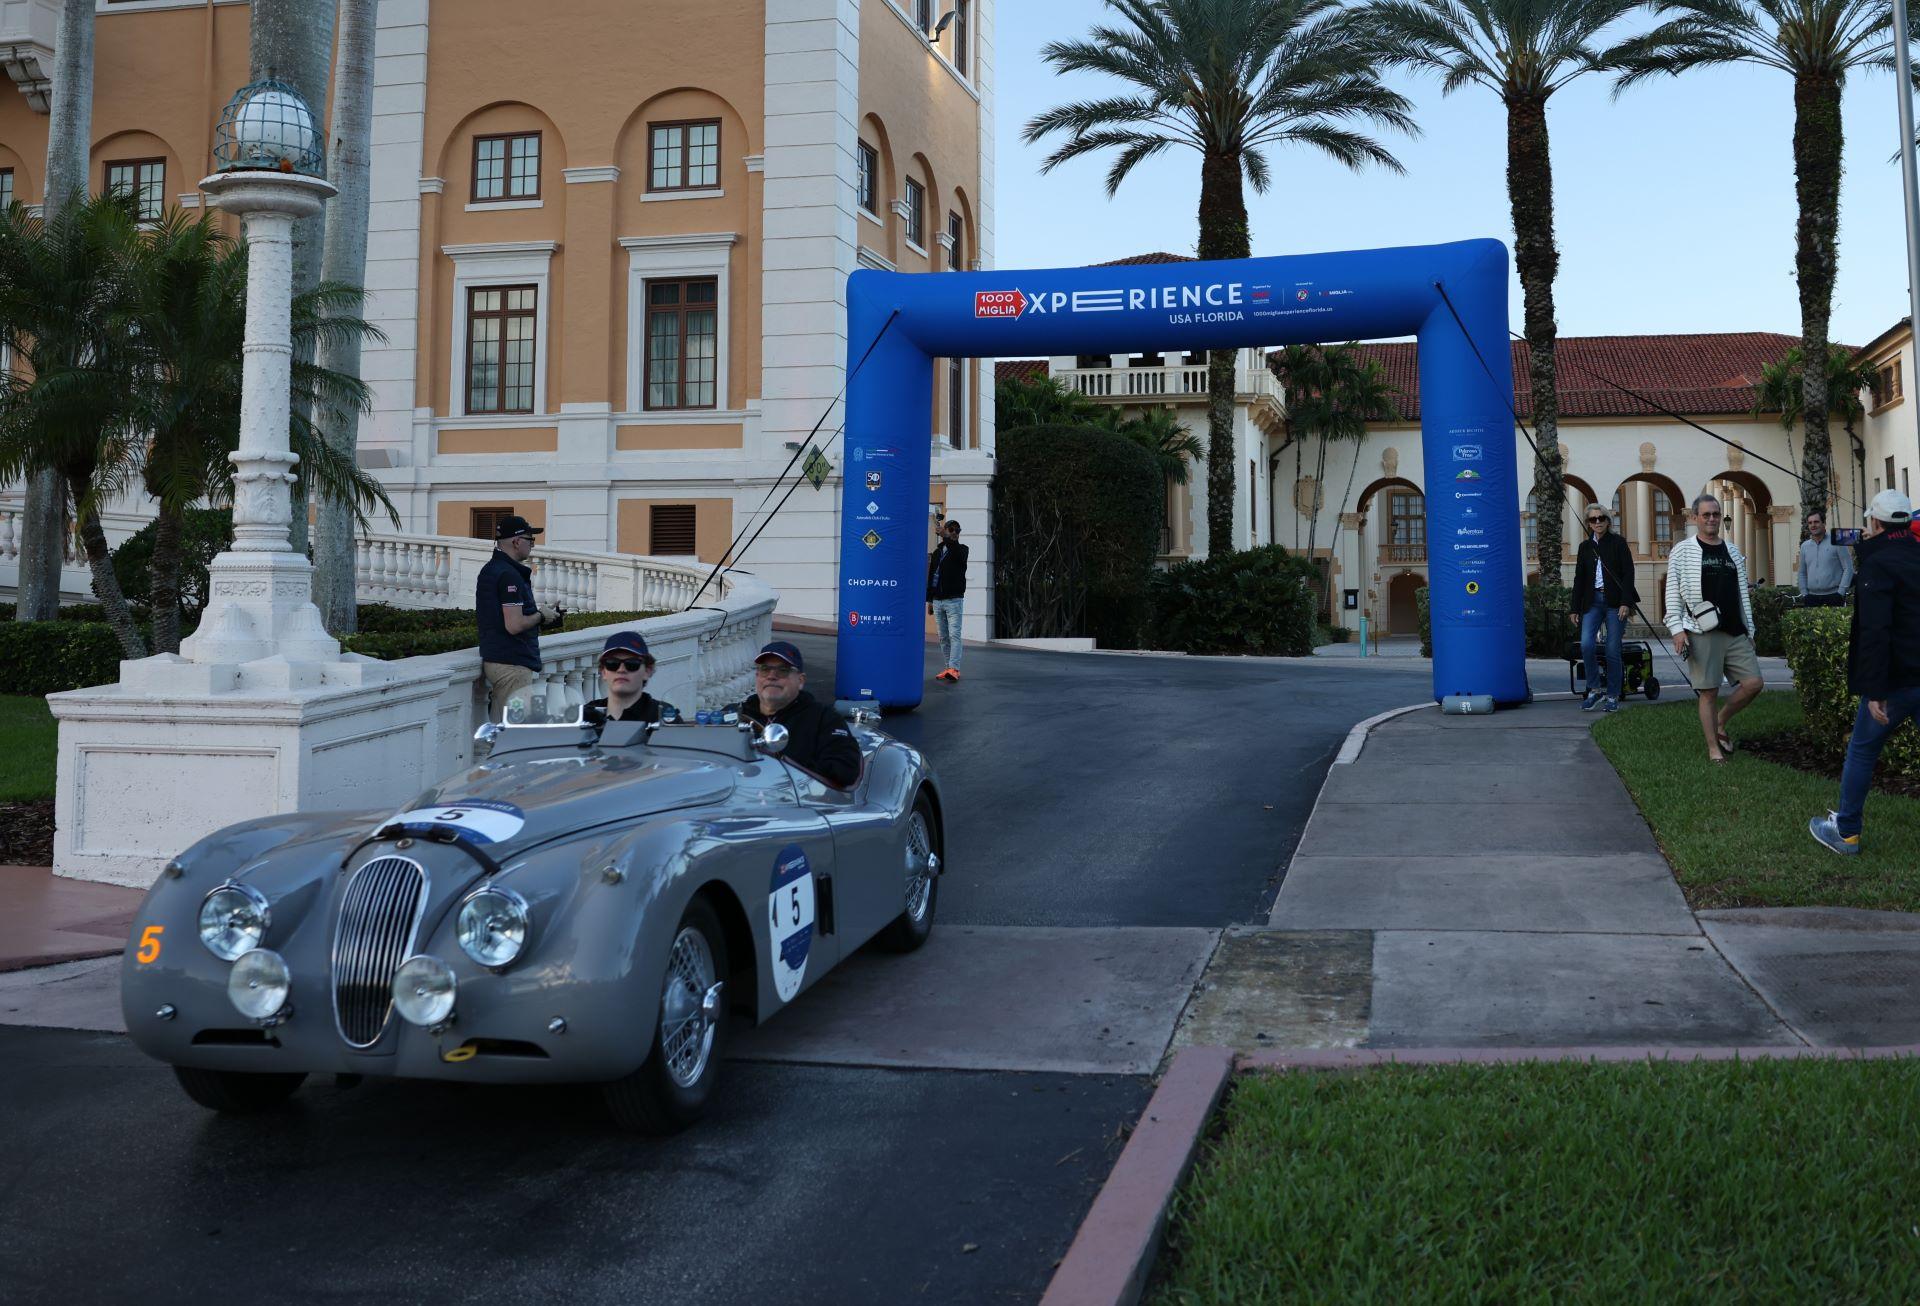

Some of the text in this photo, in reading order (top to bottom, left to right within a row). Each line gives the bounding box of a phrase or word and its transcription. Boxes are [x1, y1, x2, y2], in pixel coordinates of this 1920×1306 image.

[980, 293, 1014, 303] 1000
[978, 305, 1016, 316] MIGLIA
[1169, 311, 1244, 325] USA FLORIDA
[847, 578, 899, 587] CHOPARD
[434, 808, 472, 821] 5
[791, 886, 800, 926] 5
[136, 925, 165, 964] 5
